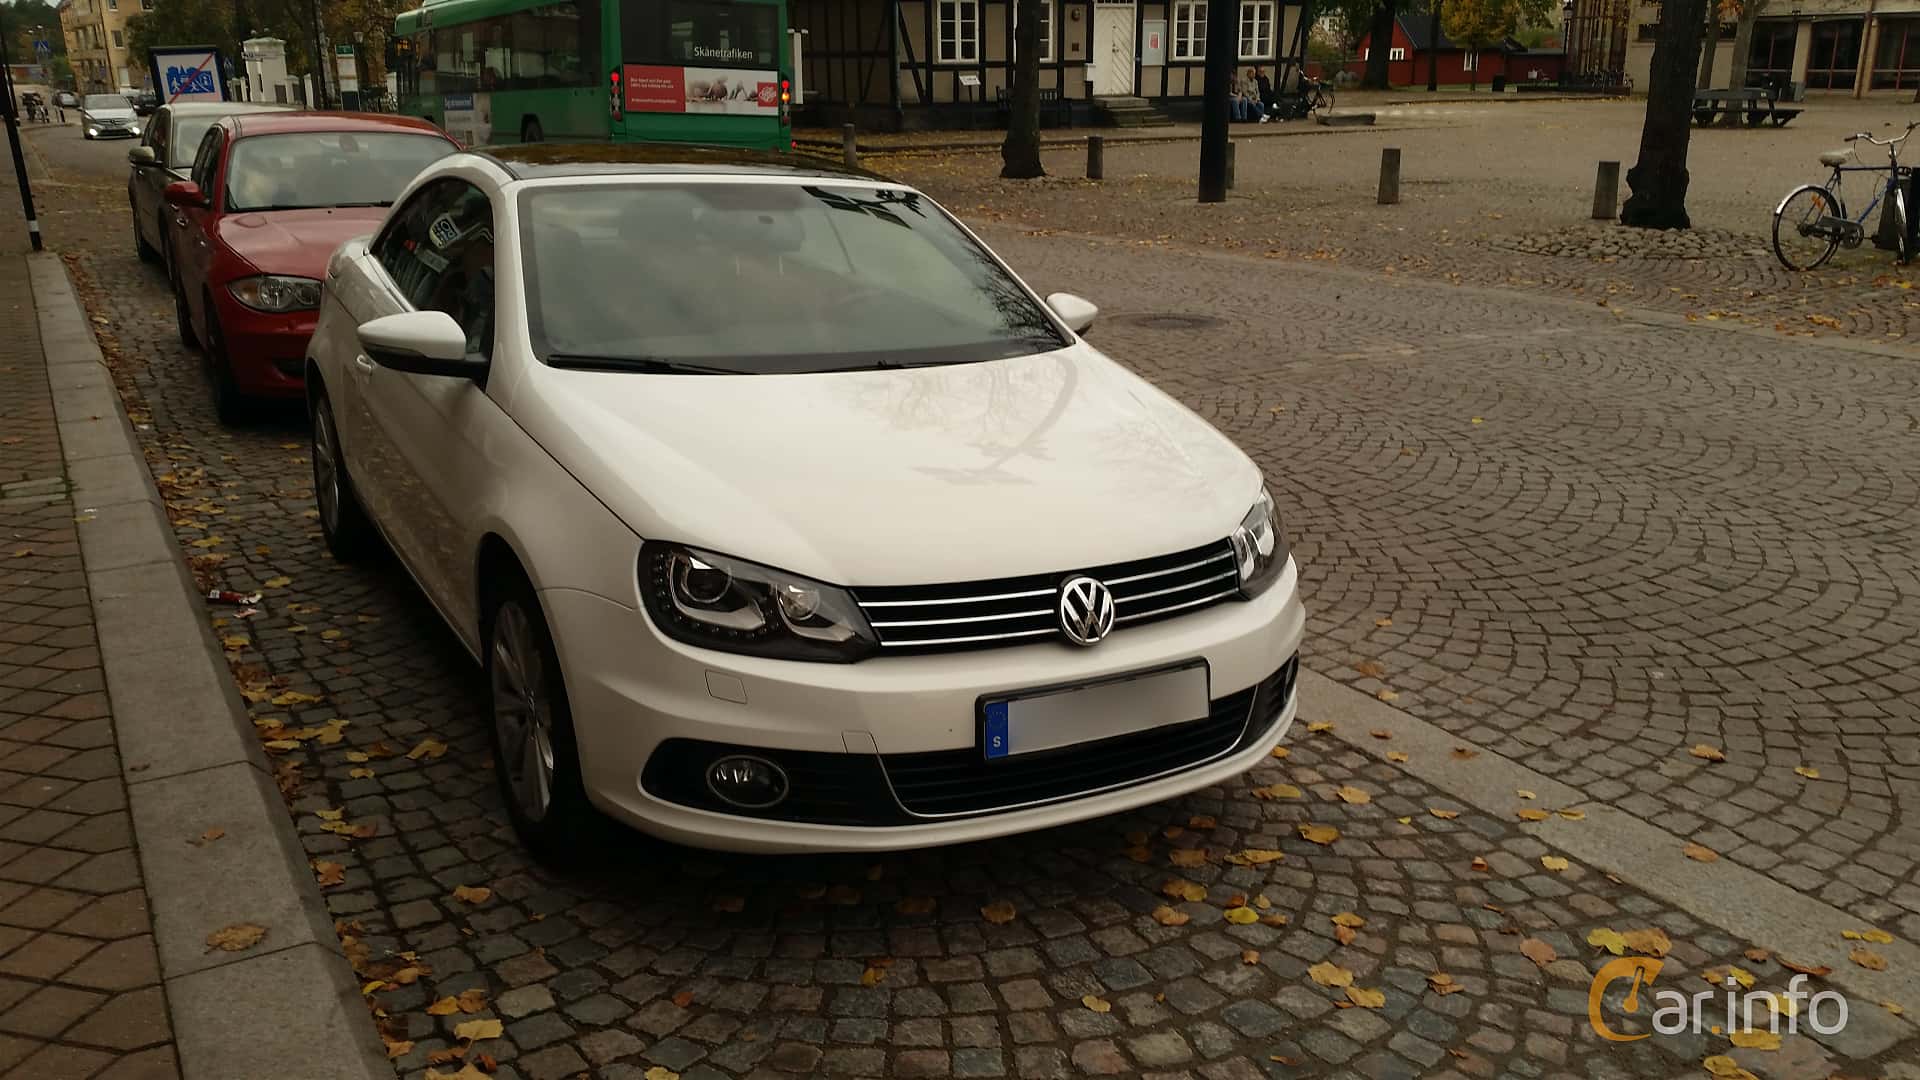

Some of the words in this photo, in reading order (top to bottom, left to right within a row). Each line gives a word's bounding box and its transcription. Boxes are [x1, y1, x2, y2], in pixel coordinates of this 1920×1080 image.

[694, 46, 753, 60] Skånetrafiken
[1061, 577, 1114, 644] VW
[993, 735, 1001, 748] S
